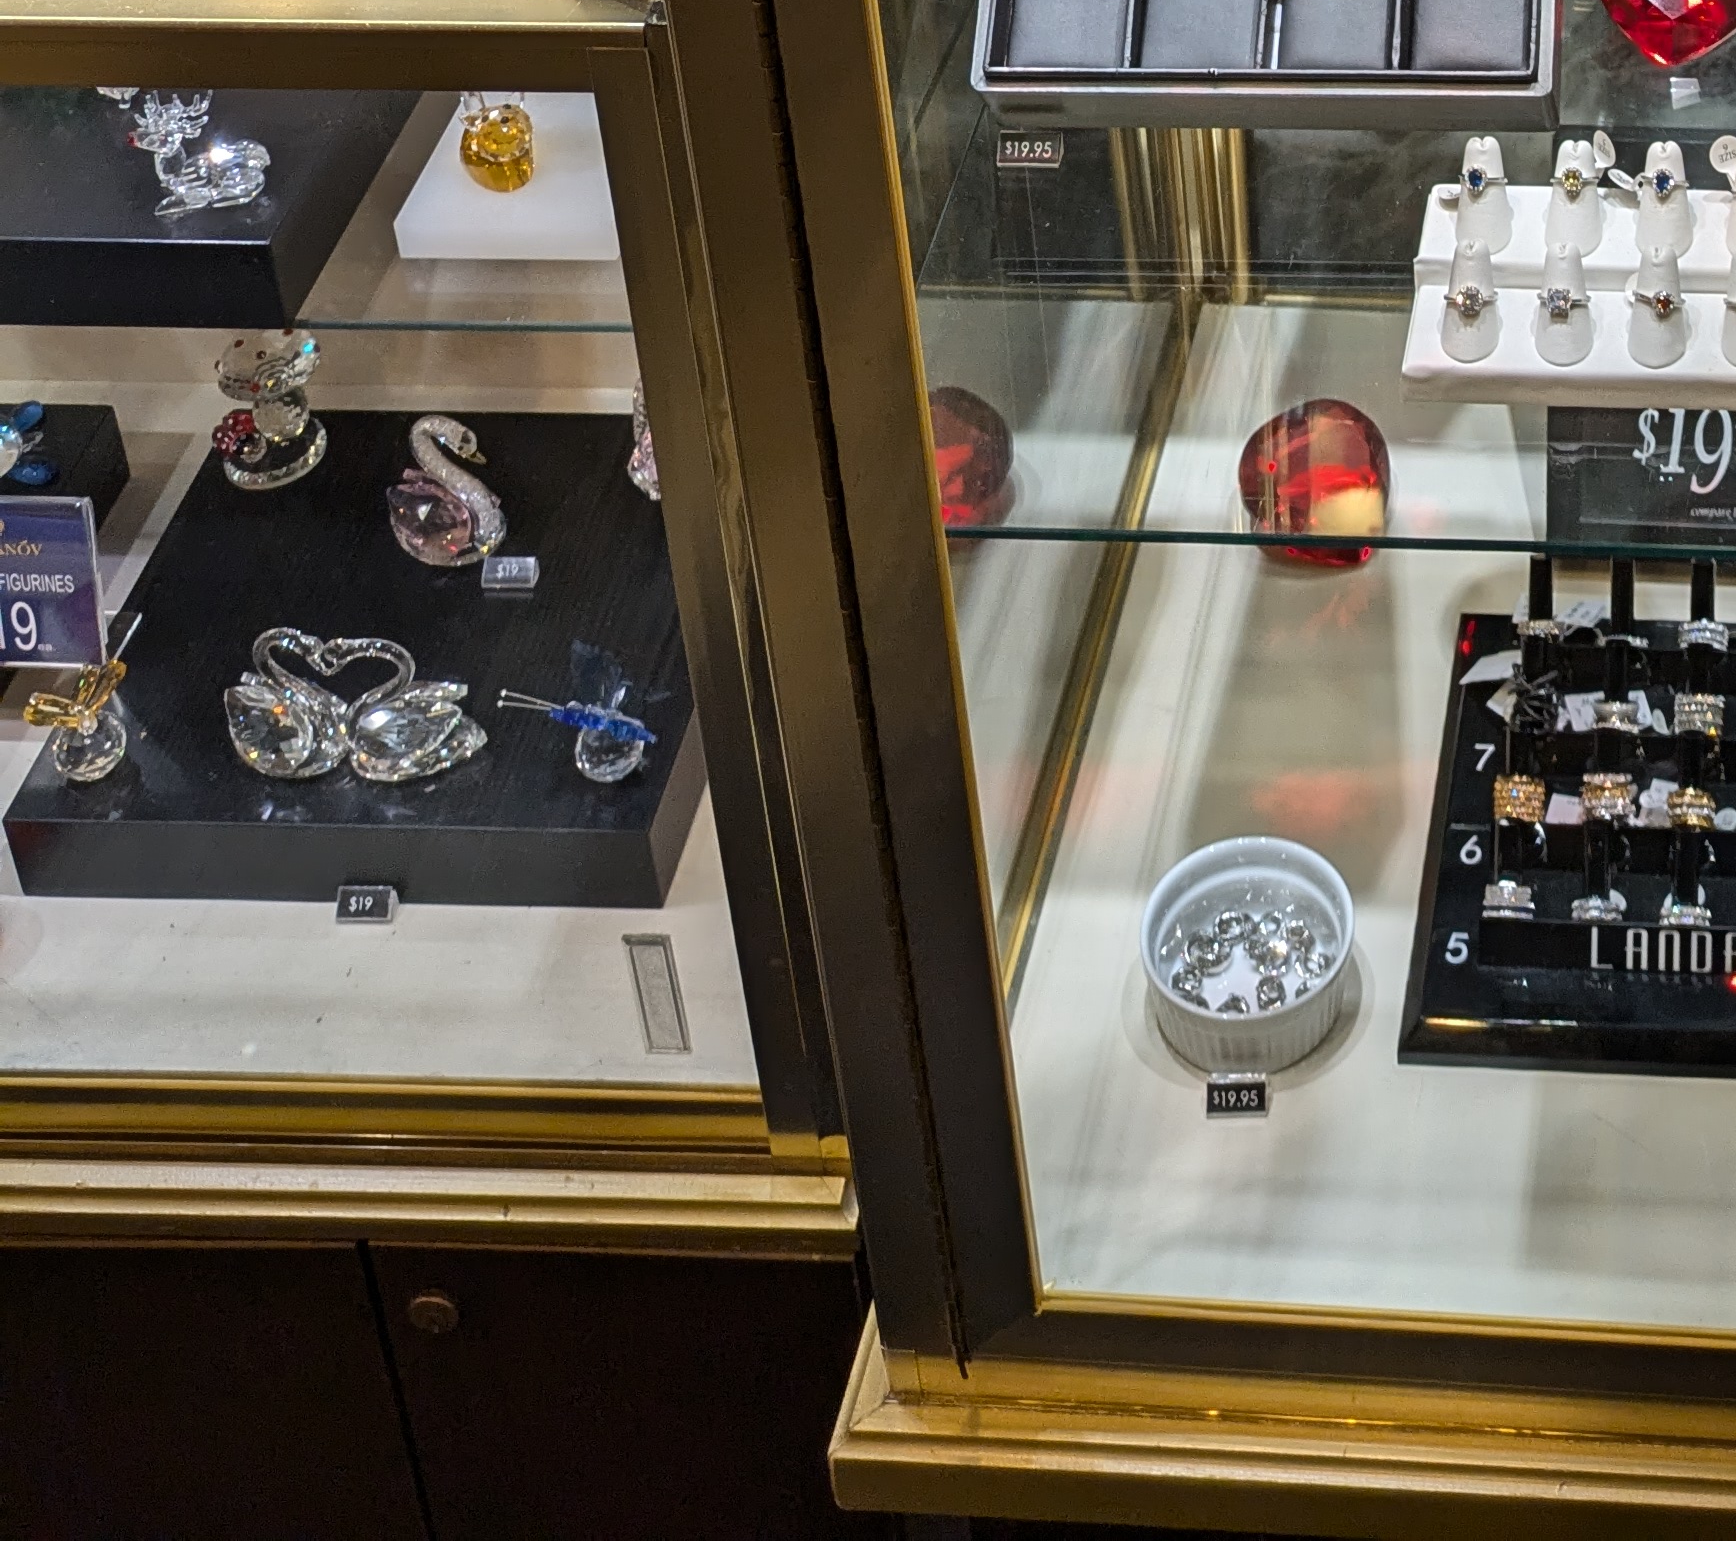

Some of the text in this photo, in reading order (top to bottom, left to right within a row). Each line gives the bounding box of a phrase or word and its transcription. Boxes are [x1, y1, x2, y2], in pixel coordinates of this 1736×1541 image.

[1004, 140, 1053, 158] $19.95
[1632, 407, 1733, 494] $19
[1474, 744, 1497, 772] 7
[1460, 835, 1484, 866] 6
[349, 896, 374, 913] $19
[1445, 931, 1470, 964] 5
[1212, 1090, 1259, 1108] $19.95
